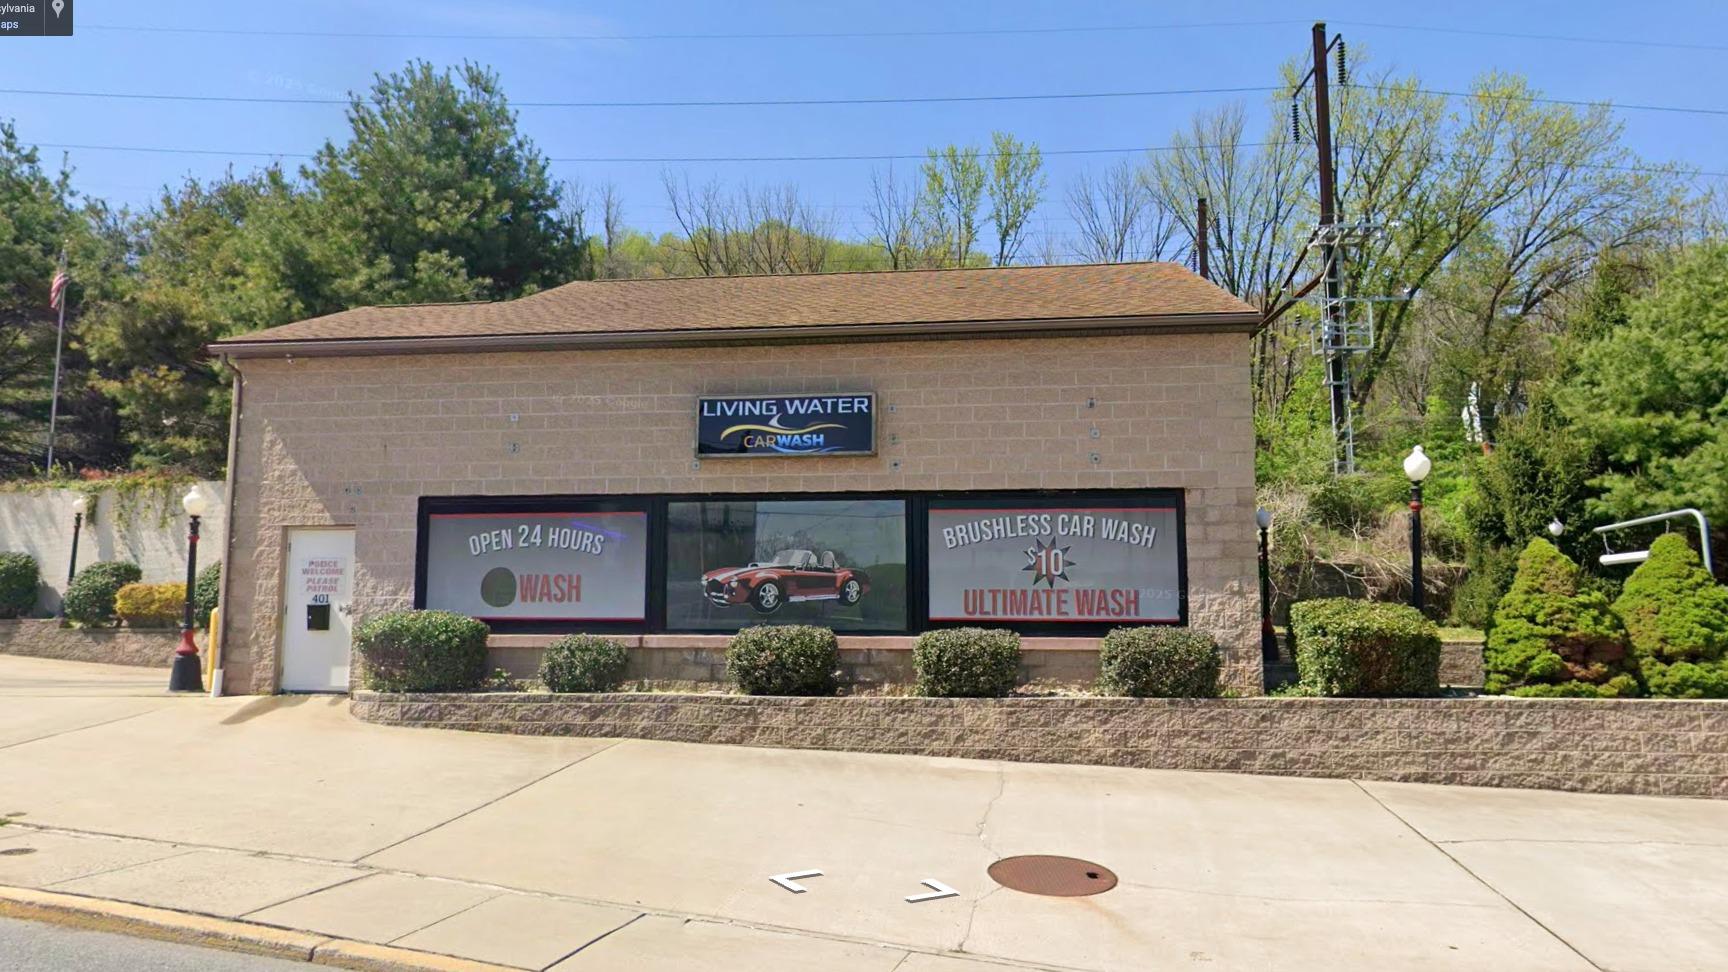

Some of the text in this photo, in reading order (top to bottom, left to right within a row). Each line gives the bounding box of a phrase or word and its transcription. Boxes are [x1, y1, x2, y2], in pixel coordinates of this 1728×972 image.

[703, 397, 869, 417] LIVING WATER
[468, 524, 605, 556] OPEN 24 HOURS
[943, 513, 1158, 549] BRUSHLESS CAR WASH
[302, 568, 345, 576] WELCOME
[1026, 546, 1065, 577] $10
[312, 594, 329, 604] 401
[519, 573, 582, 603] WASH
[963, 588, 1140, 617] ULTIMATE WASH
